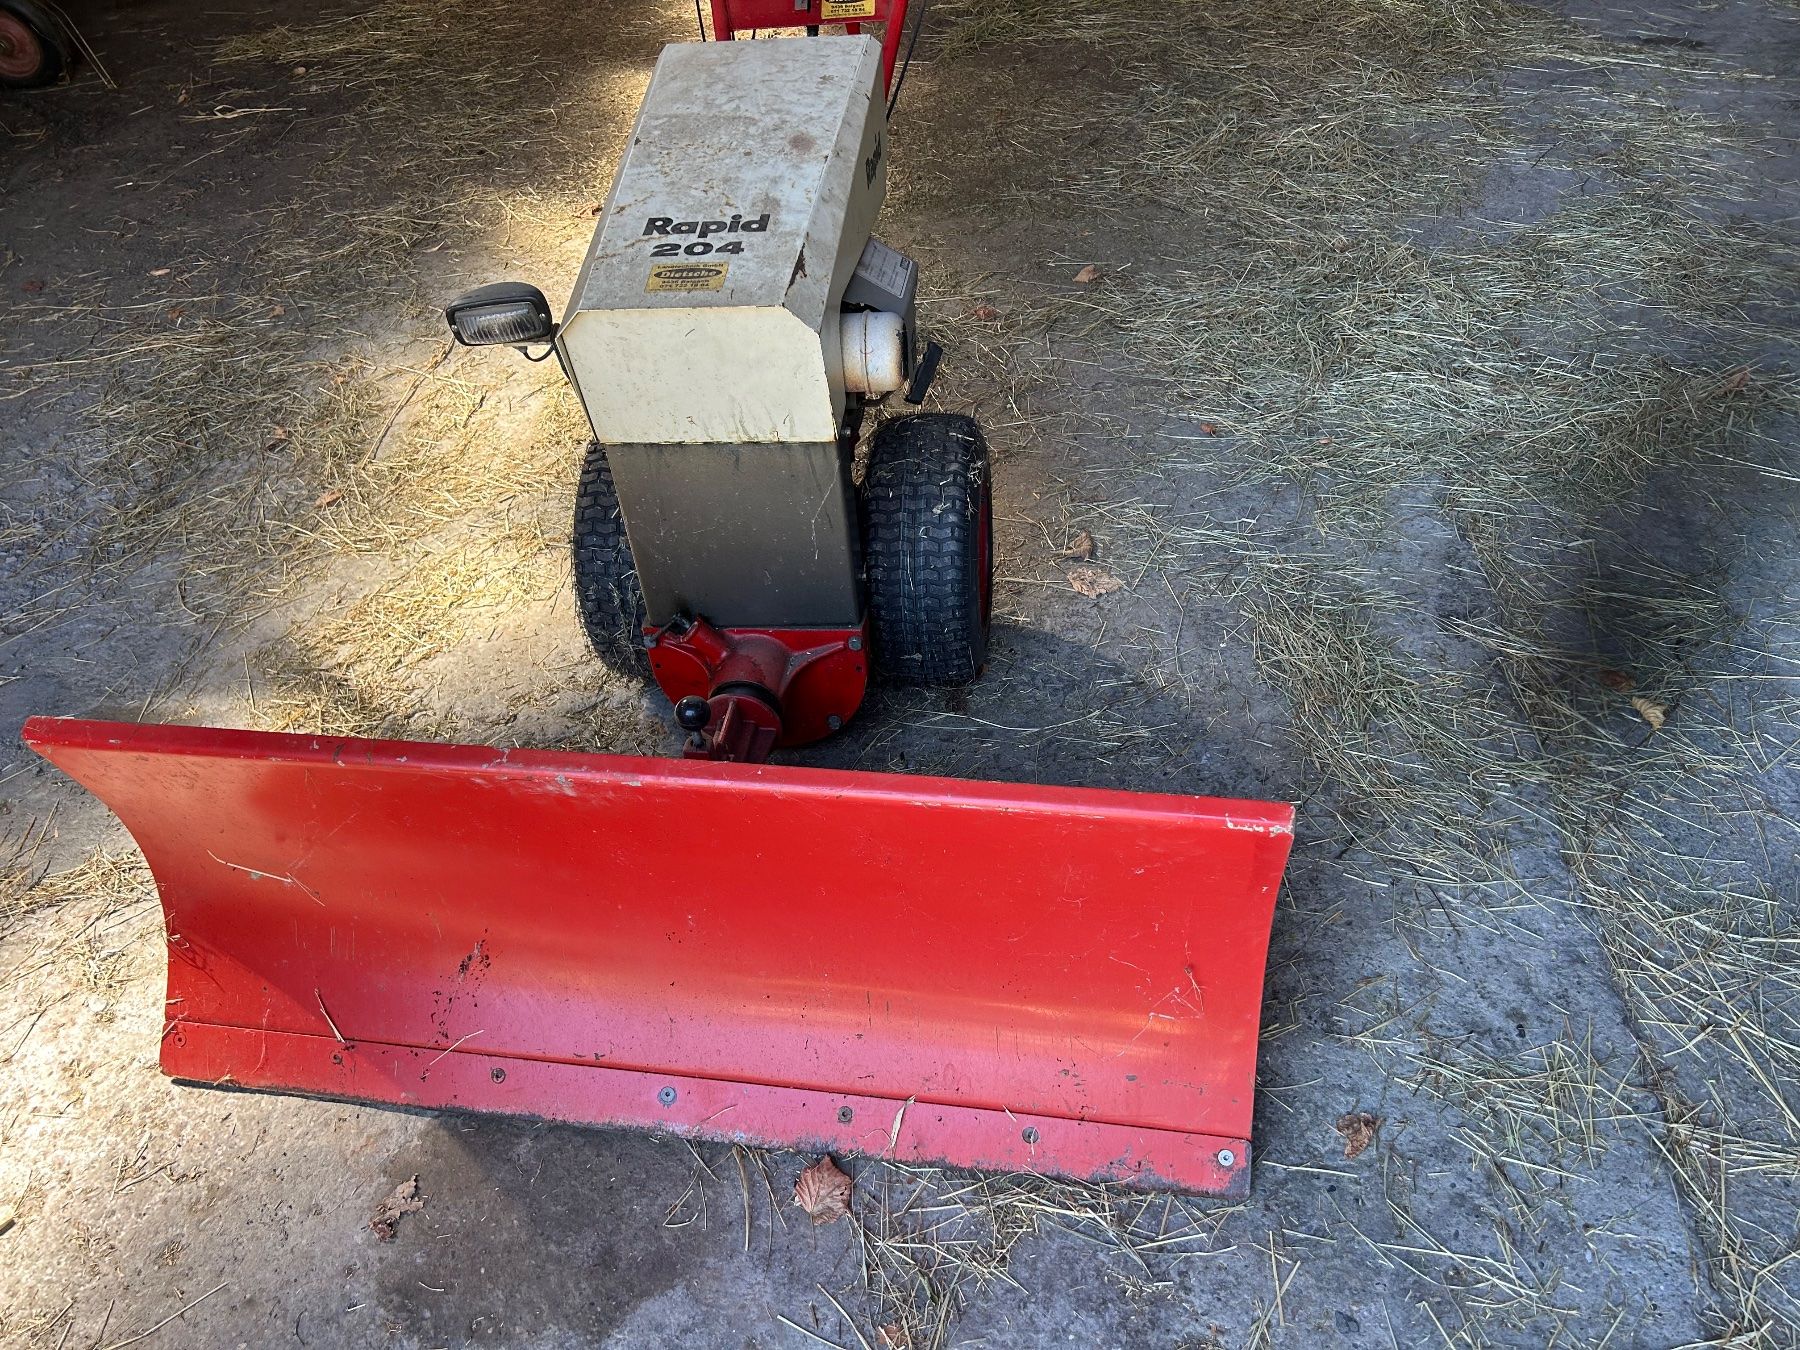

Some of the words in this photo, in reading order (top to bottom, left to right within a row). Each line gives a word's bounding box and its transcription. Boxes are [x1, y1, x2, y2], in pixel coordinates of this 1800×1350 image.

[642, 214, 770, 238] Rapid
[649, 241, 744, 257] 204
[661, 270, 716, 278] Dietsche
